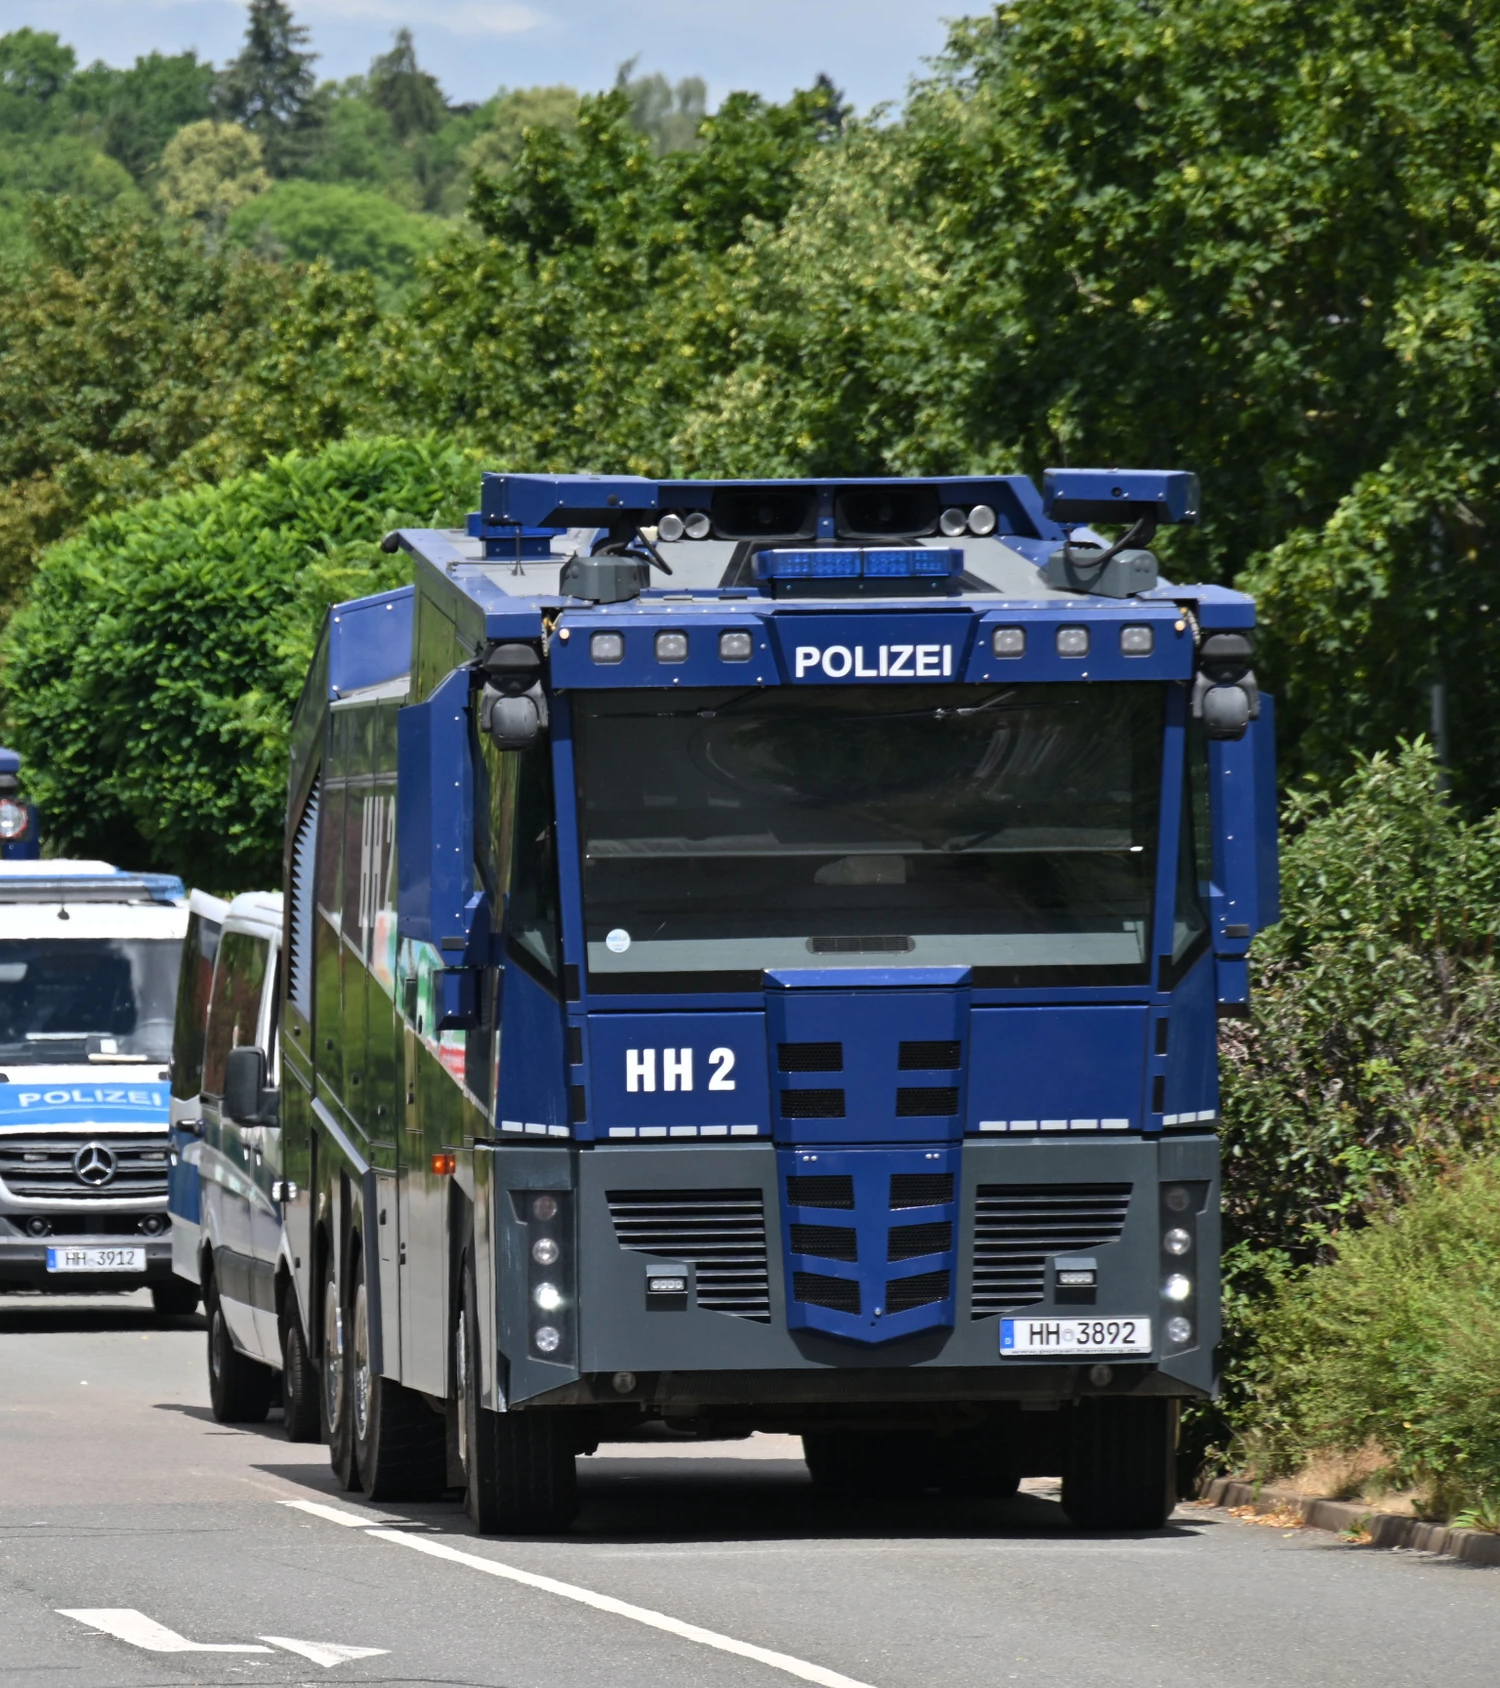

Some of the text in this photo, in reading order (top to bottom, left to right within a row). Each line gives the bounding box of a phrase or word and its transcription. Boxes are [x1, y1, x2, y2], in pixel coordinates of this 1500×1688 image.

[795, 645, 952, 678] POLIZEI
[626, 1047, 736, 1092] HH 2
[18, 1089, 162, 1108] POLIZEI
[66, 1252, 86, 1266] HH
[97, 1251, 135, 1266] 3912
[1029, 1322, 1135, 1345] HH 3892
